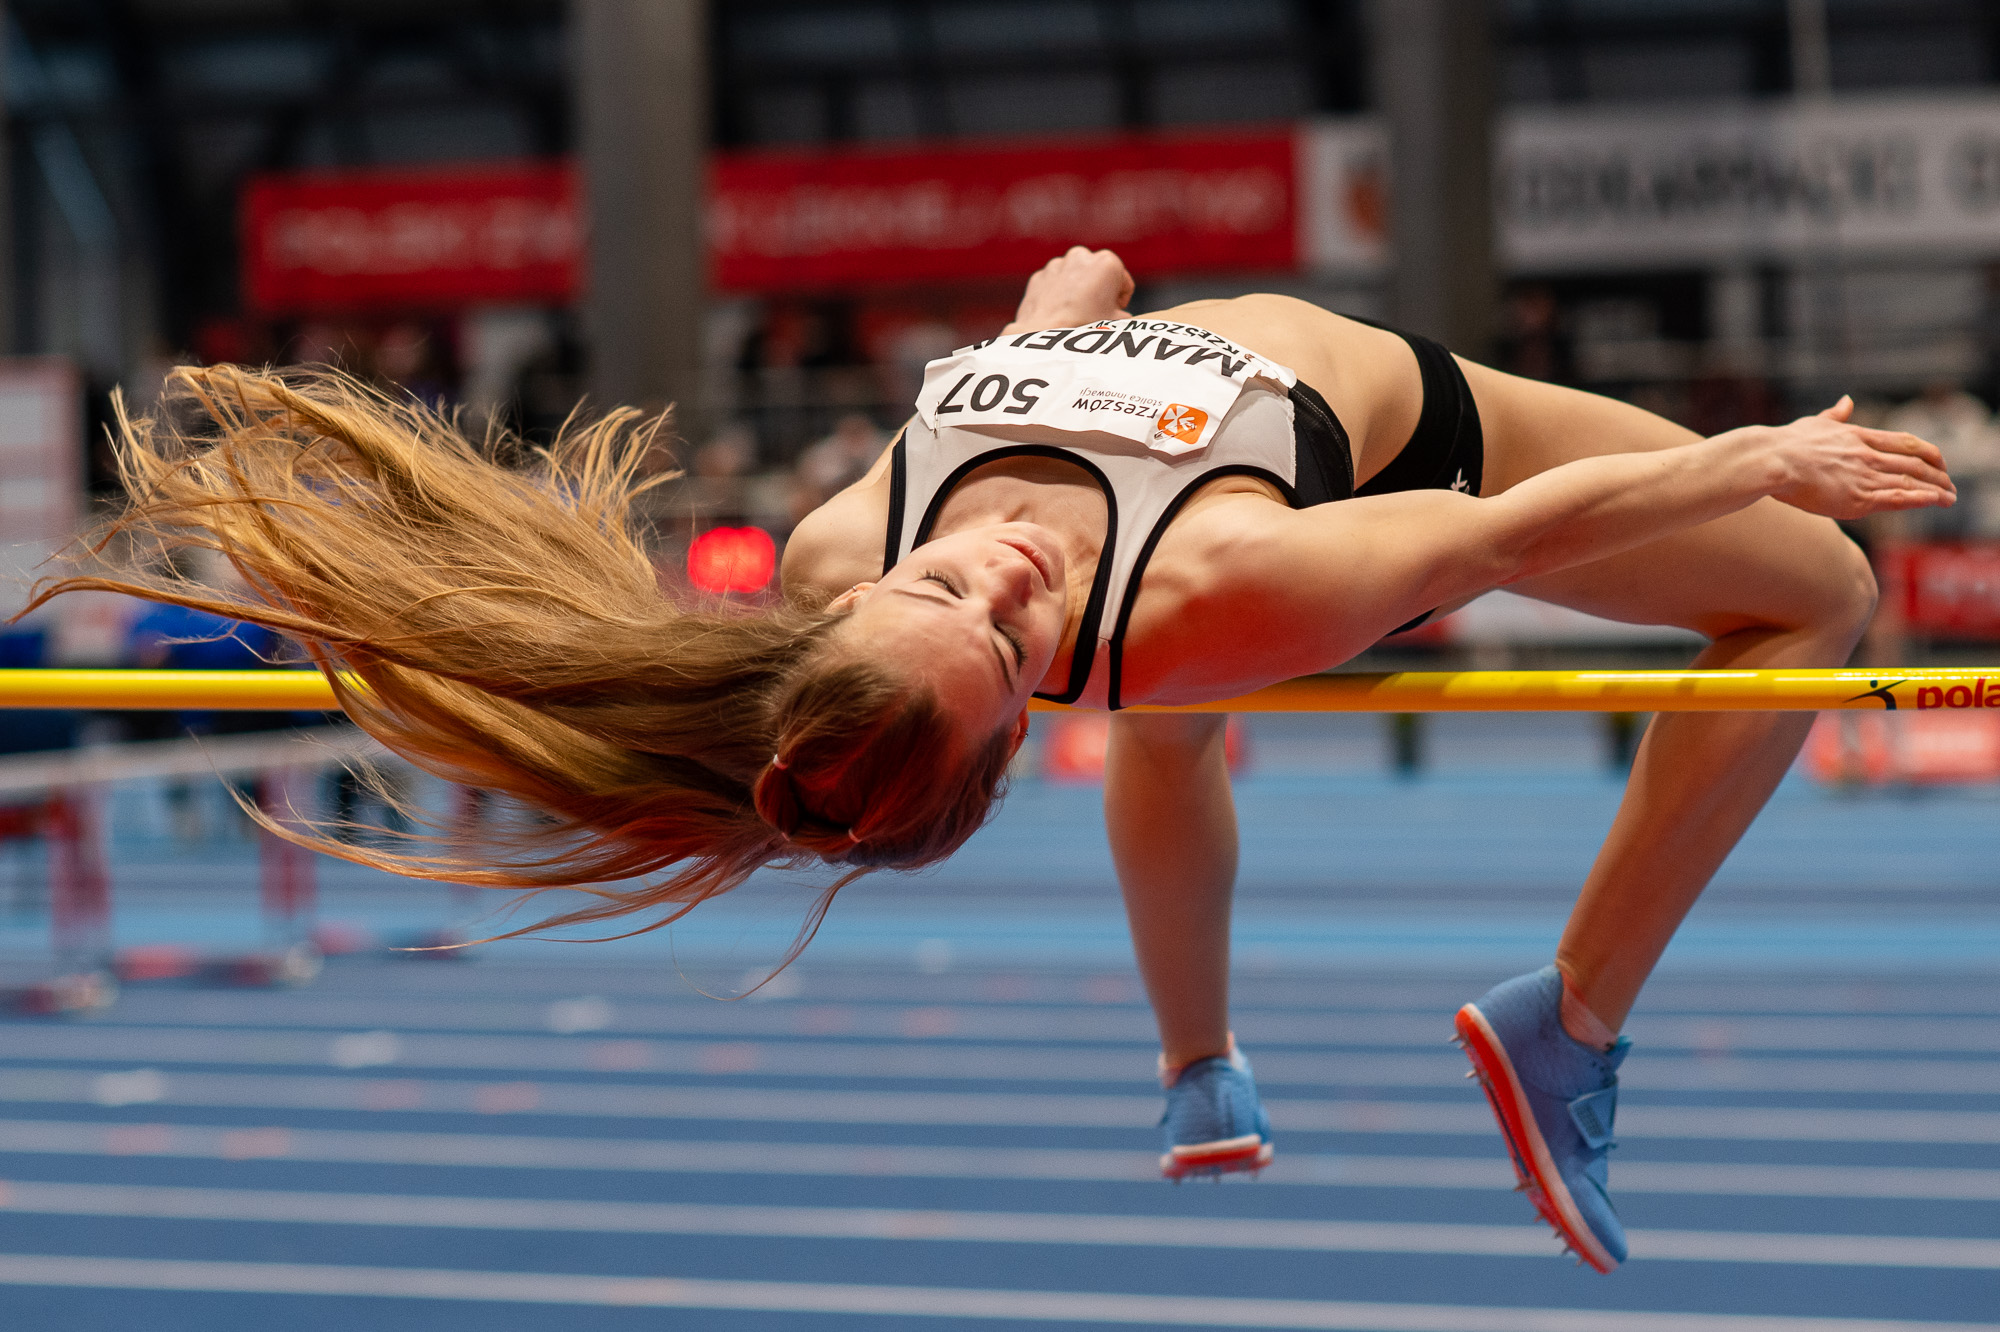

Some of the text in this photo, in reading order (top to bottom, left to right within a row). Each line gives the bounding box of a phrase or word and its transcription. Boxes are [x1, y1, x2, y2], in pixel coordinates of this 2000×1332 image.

[936, 372, 1050, 415] 507
[1079, 387, 1163, 407] stolica innowacji
[1072, 398, 1159, 419] rzeszów
